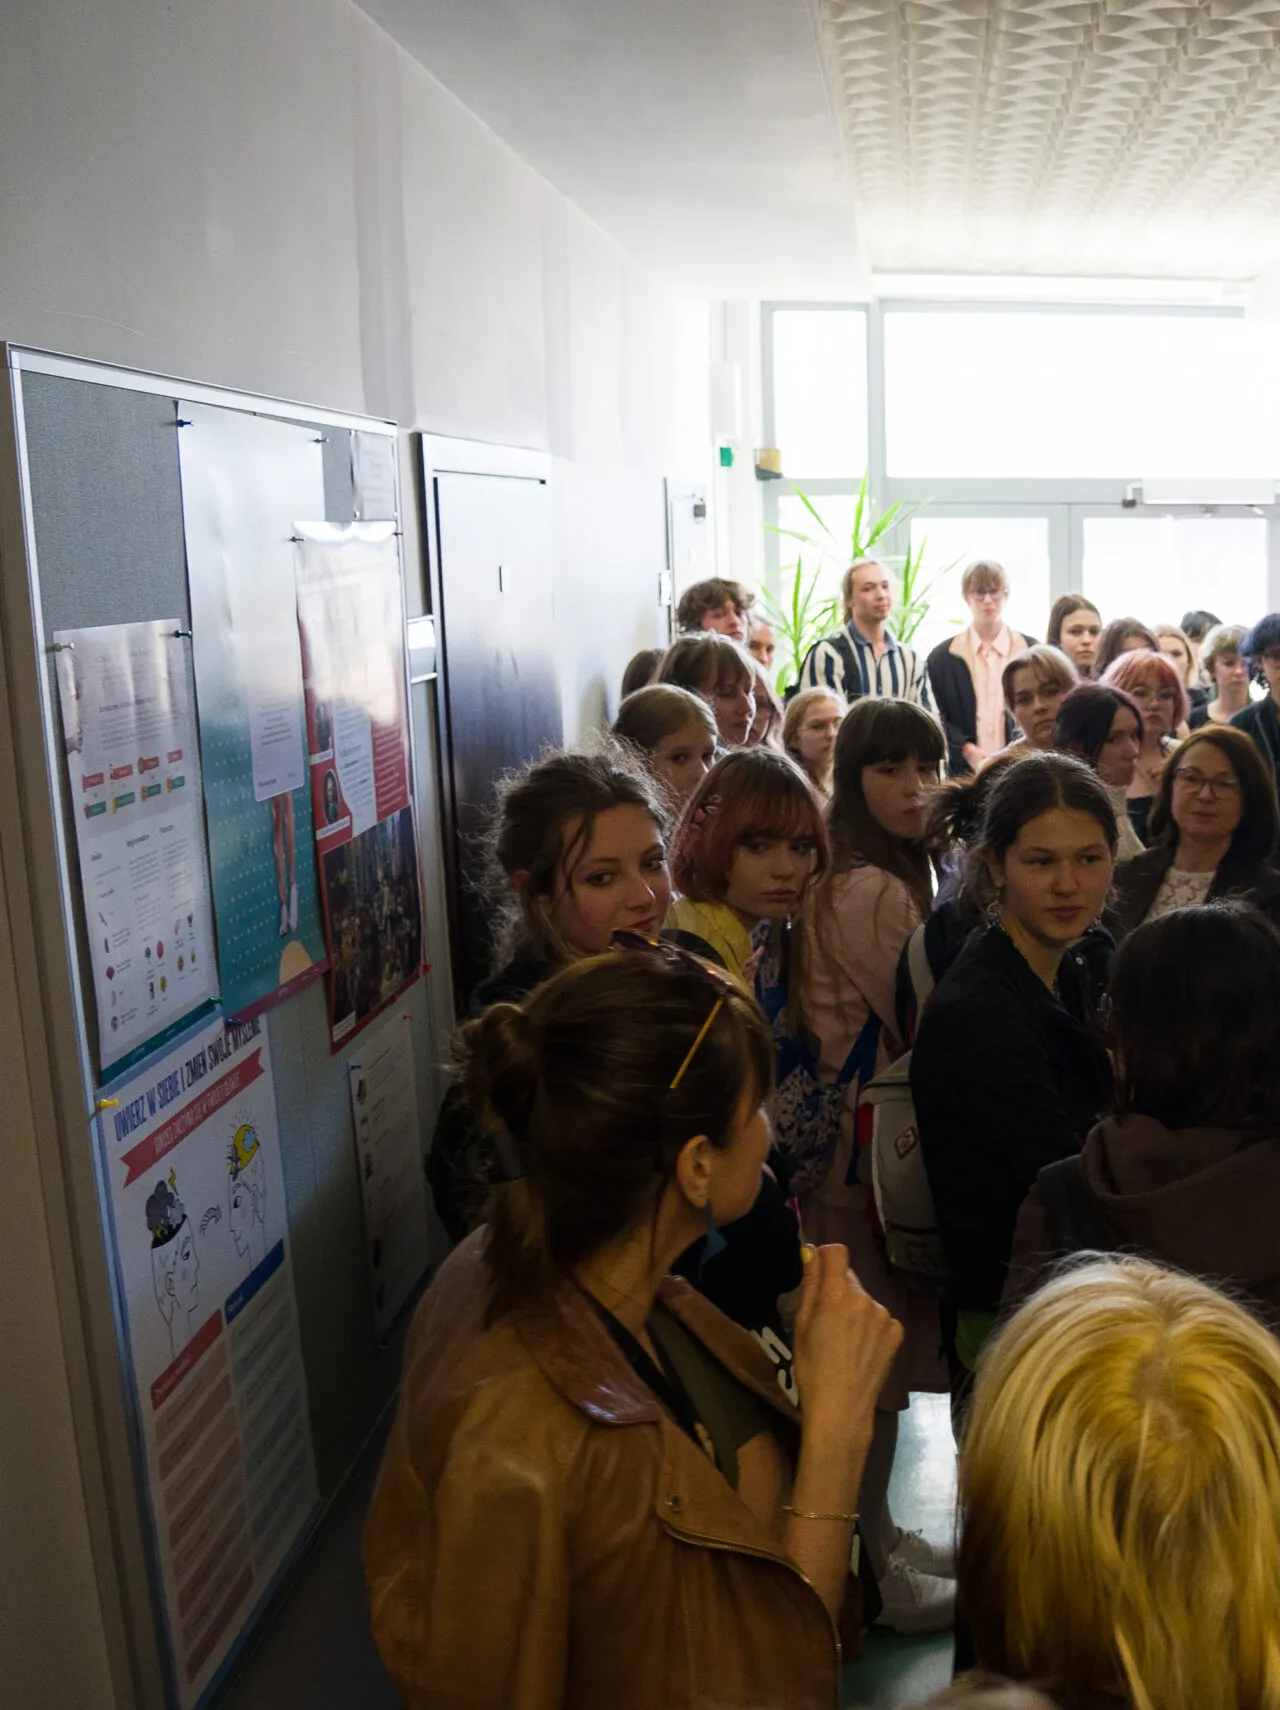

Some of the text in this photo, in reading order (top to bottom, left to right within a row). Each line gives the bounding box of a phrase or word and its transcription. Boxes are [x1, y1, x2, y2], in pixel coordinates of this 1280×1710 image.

[113, 1095, 147, 1142] UWIERZ
[145, 1087, 157, 1117] W
[157, 1070, 181, 1109] SIEBIE
[180, 1066, 186, 1092] I
[207, 1033, 232, 1070] SWOJE
